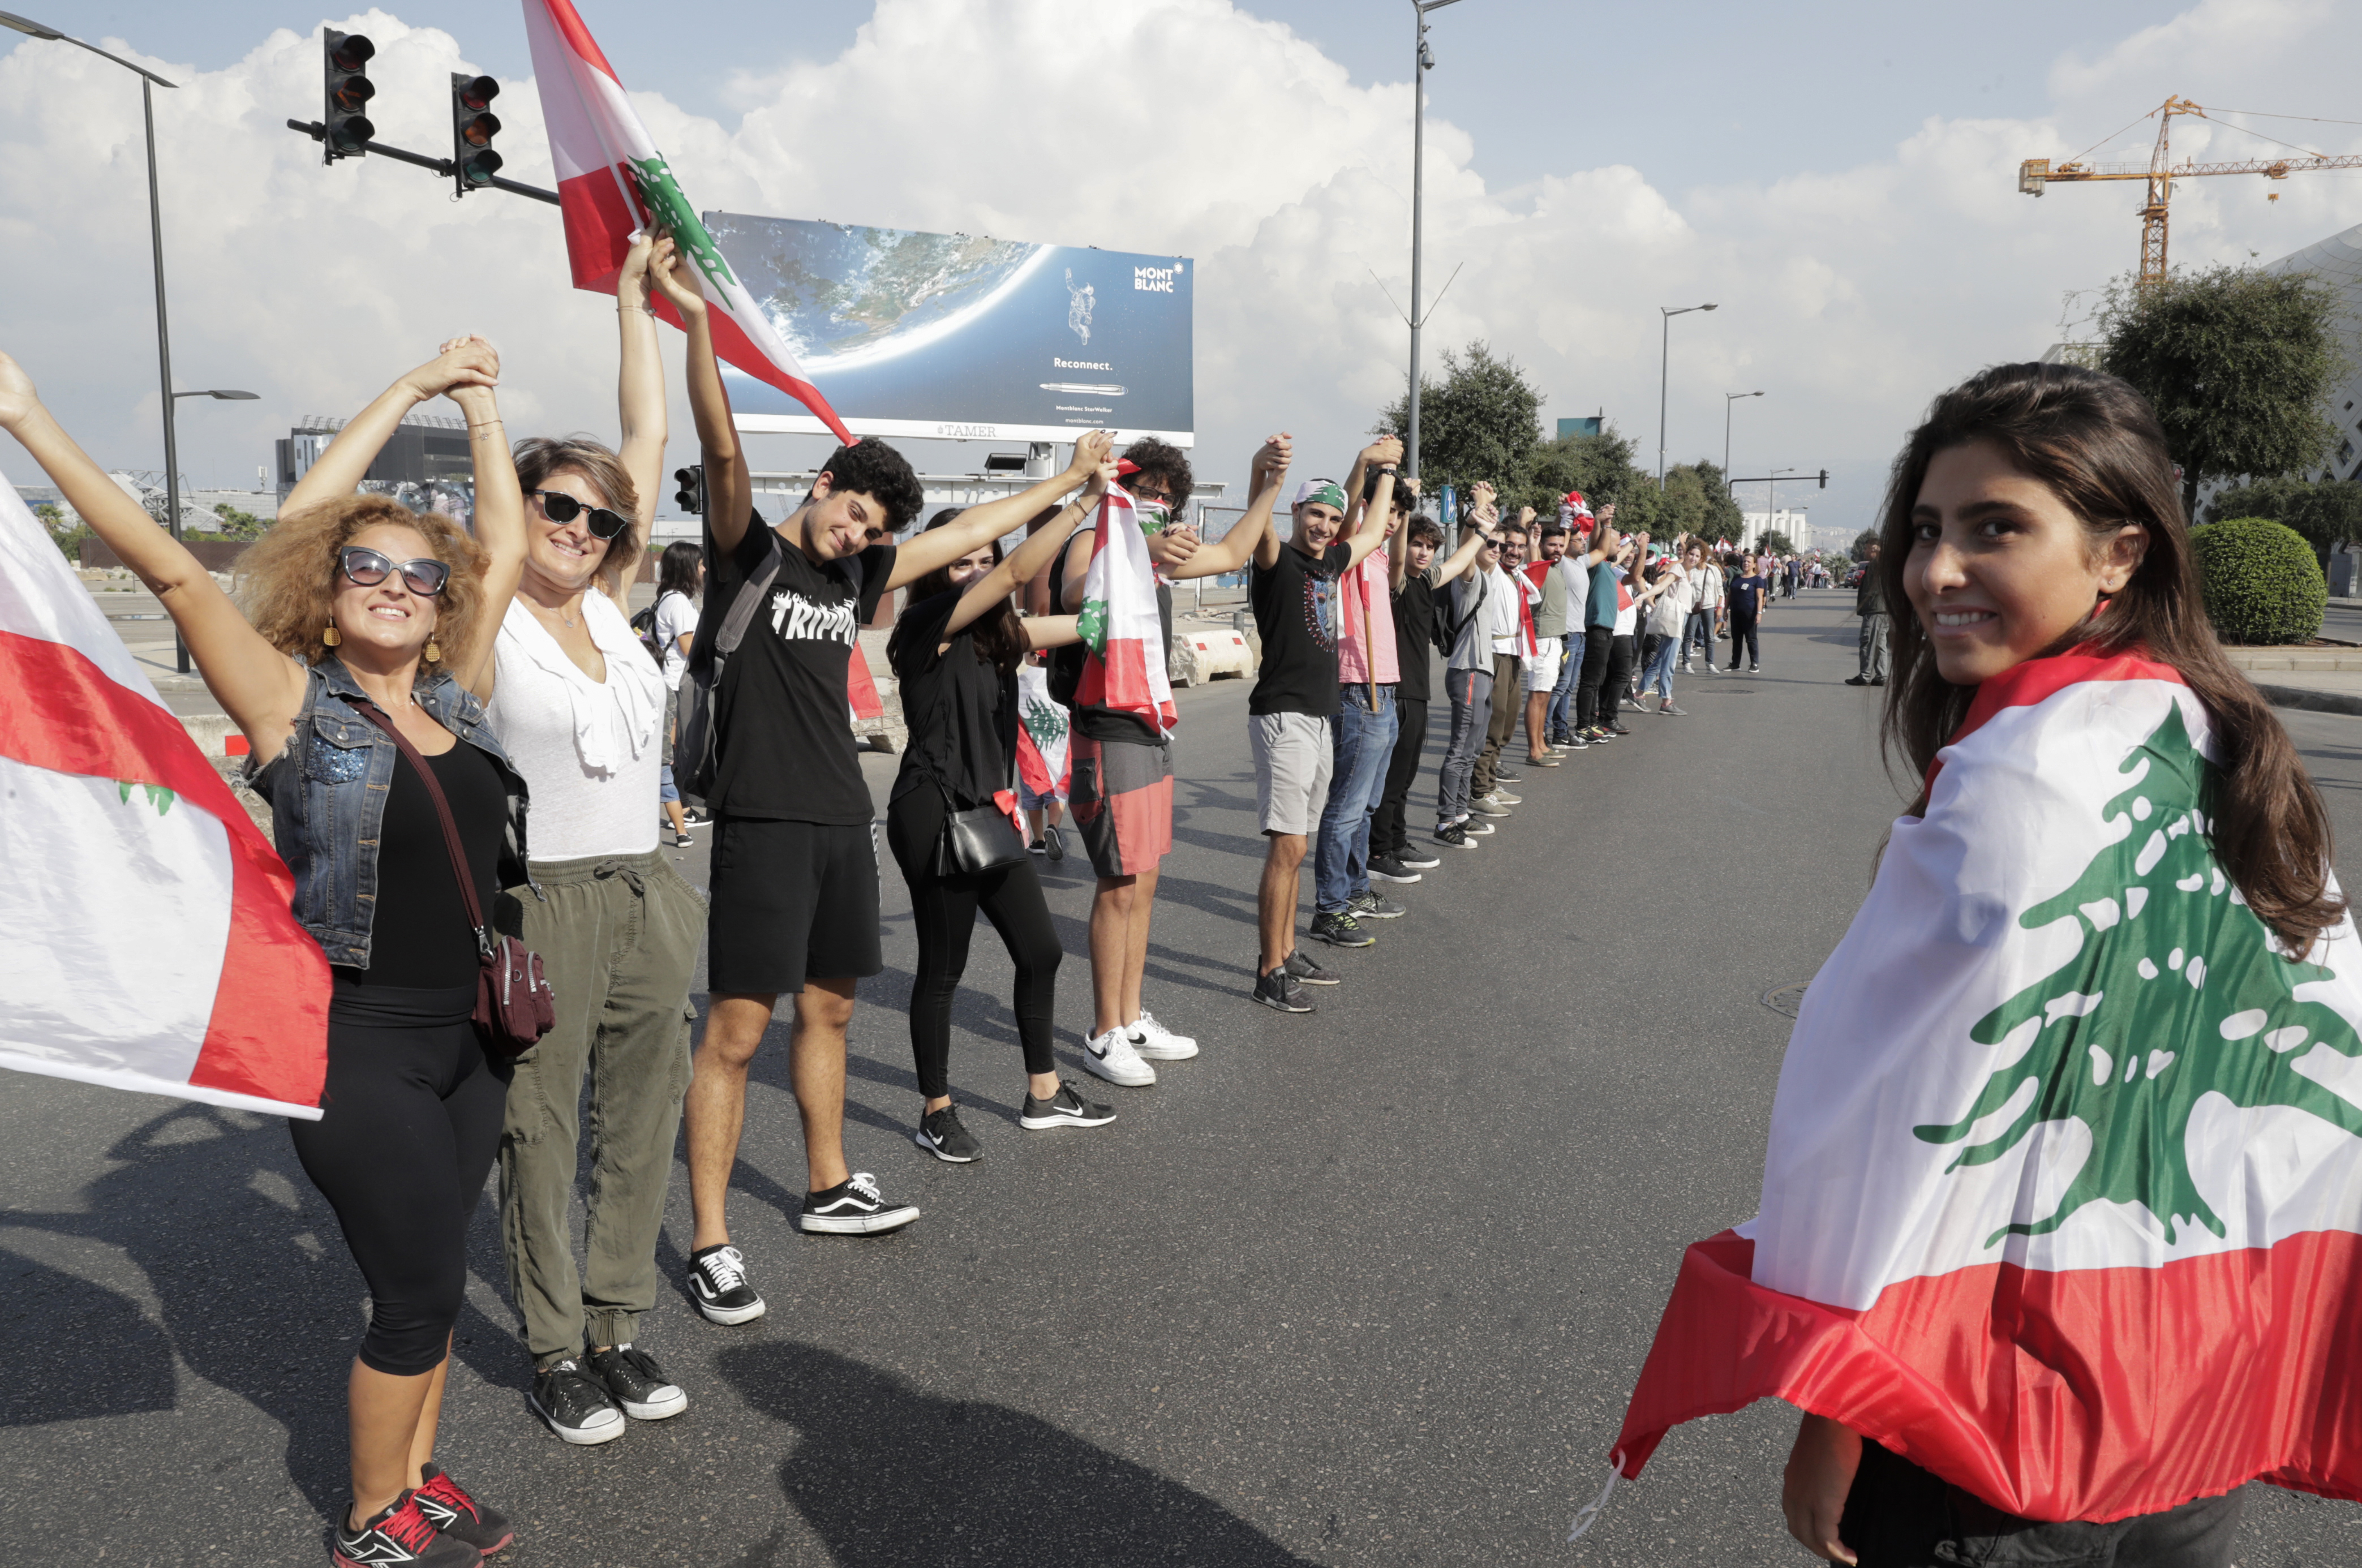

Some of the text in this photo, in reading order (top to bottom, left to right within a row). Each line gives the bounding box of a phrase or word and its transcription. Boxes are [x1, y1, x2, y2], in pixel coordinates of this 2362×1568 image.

[1135, 266, 1173, 281] MONT
[1135, 278, 1173, 293] BLANC
[1054, 357, 1113, 371] Reconnect.
[945, 424, 997, 437] TAMER
